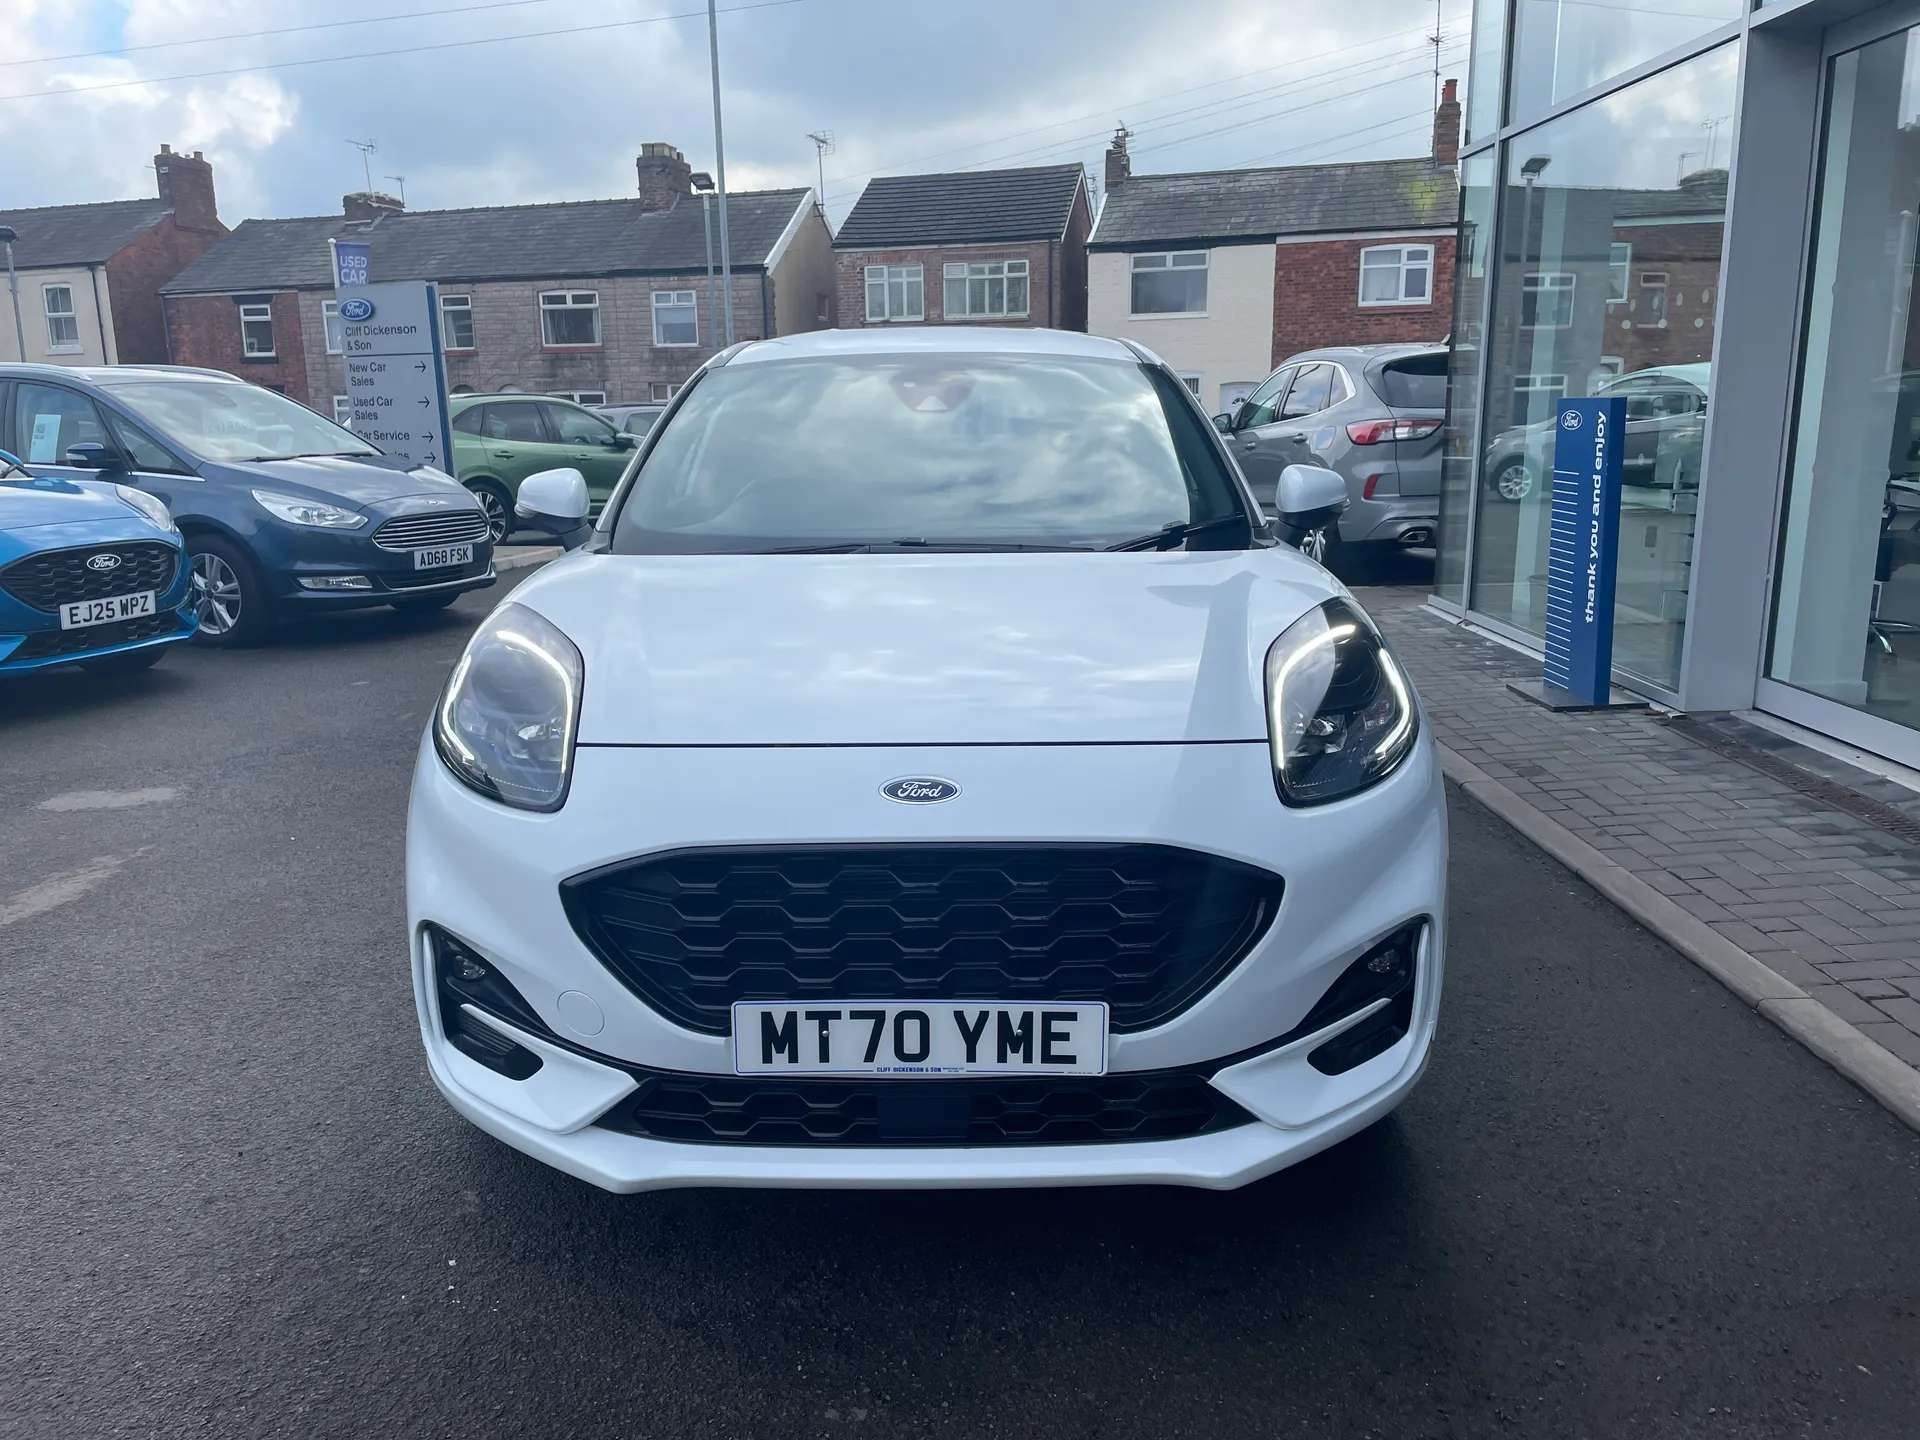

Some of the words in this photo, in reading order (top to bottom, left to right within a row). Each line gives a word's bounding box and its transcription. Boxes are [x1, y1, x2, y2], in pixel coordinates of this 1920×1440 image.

[340, 255, 368, 268] USED
[341, 268, 367, 285] CAR
[345, 325, 362, 337] Cliff
[363, 324, 417, 336] Dickenson
[347, 340, 353, 351] &
[354, 339, 372, 351] Son
[349, 362, 368, 373] New
[369, 361, 386, 373] Car
[351, 376, 375, 387] Sales
[353, 396, 375, 407] Used
[376, 395, 394, 407] Car
[355, 410, 378, 421] Sales
[373, 430, 410, 441] Service
[1594, 410, 1607, 471] enjoy
[1592, 474, 1602, 516] and
[1589, 520, 1599, 559] you
[420, 551, 448, 567] AD68
[449, 546, 469, 562] FSK
[1584, 562, 1597, 623] thank
[69, 601, 116, 625] EJ25
[120, 595, 149, 616] WPZ
[760, 1009, 930, 1064] MT70
[953, 1010, 1079, 1065] YME
